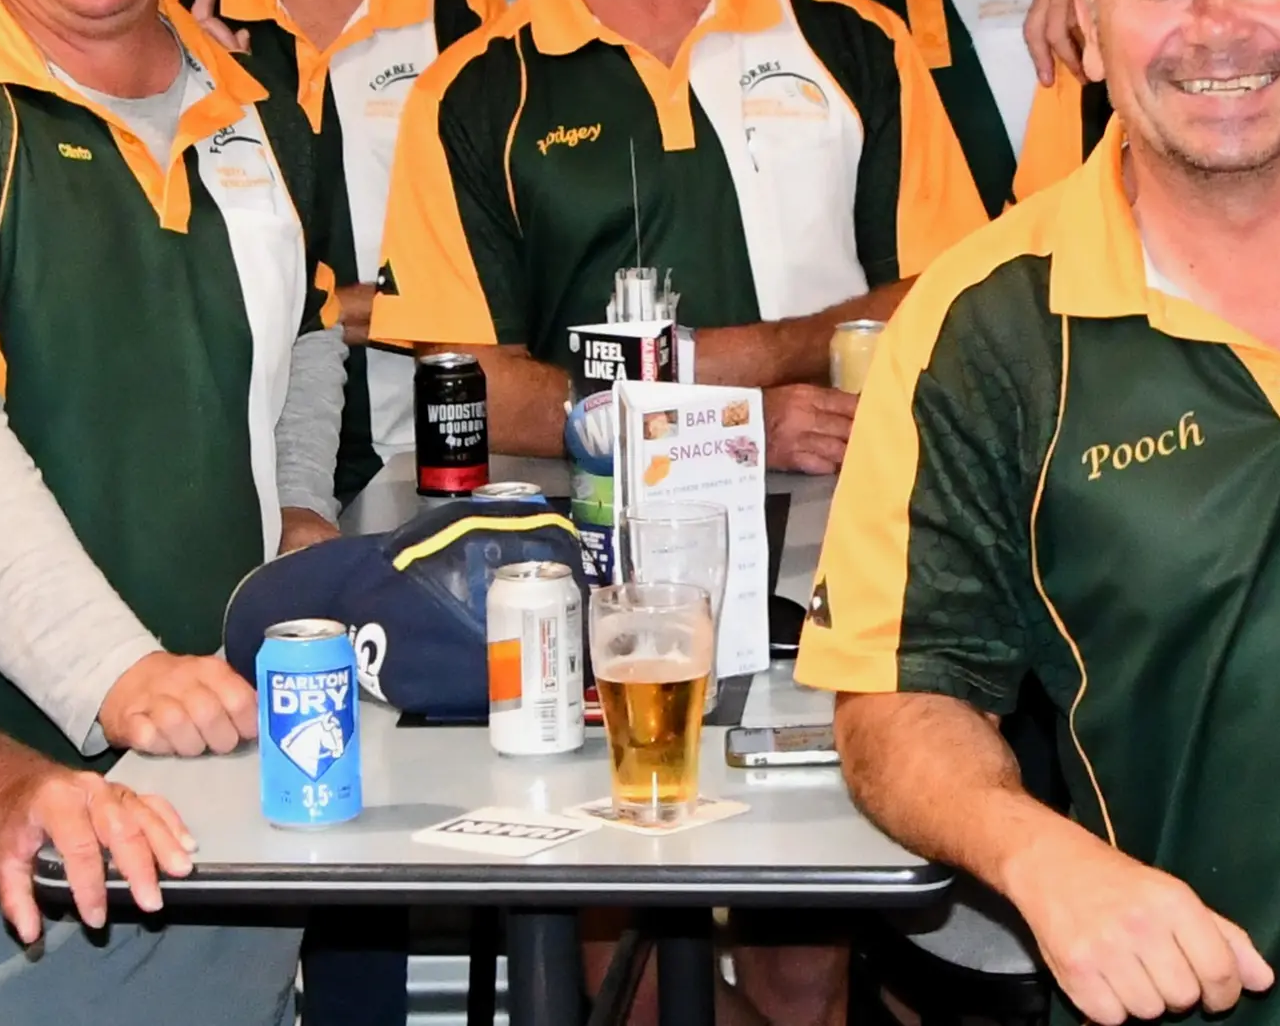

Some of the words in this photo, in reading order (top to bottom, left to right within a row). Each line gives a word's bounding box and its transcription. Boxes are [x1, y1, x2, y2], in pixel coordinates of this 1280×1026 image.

[592, 341, 626, 362] FEEL
[584, 359, 615, 380] LIKE
[686, 409, 717, 427] BAR
[670, 438, 734, 462] SNACKS
[1081, 410, 1206, 481] Pooch
[272, 670, 349, 690] CARLTON
[272, 685, 349, 715] DRY
